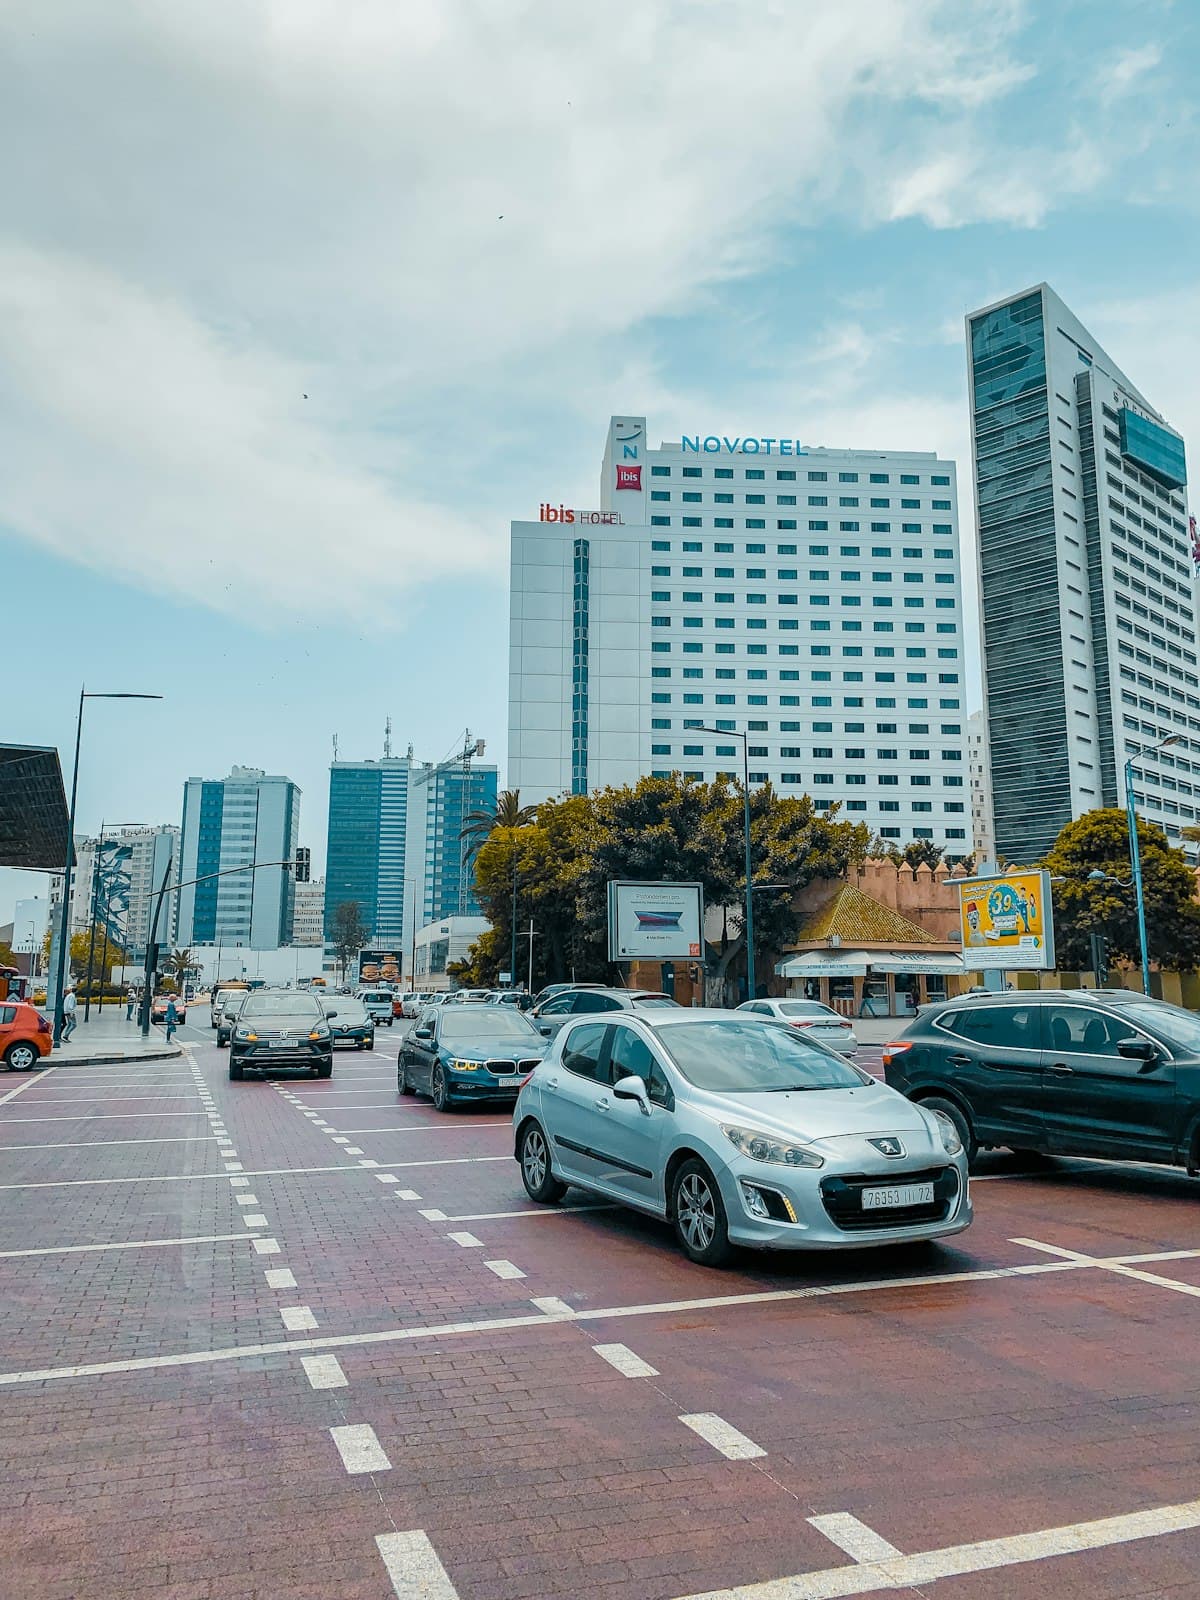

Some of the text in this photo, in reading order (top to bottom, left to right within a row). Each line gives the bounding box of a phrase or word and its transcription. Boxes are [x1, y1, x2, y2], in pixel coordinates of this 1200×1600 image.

[623, 445, 638, 459] N
[682, 435, 808, 456] NOVOTEL
[620, 471, 638, 481] ibis
[540, 503, 626, 525] ibis HOTEL
[868, 1190, 900, 1206] 76353
[919, 1187, 930, 1201] 72
